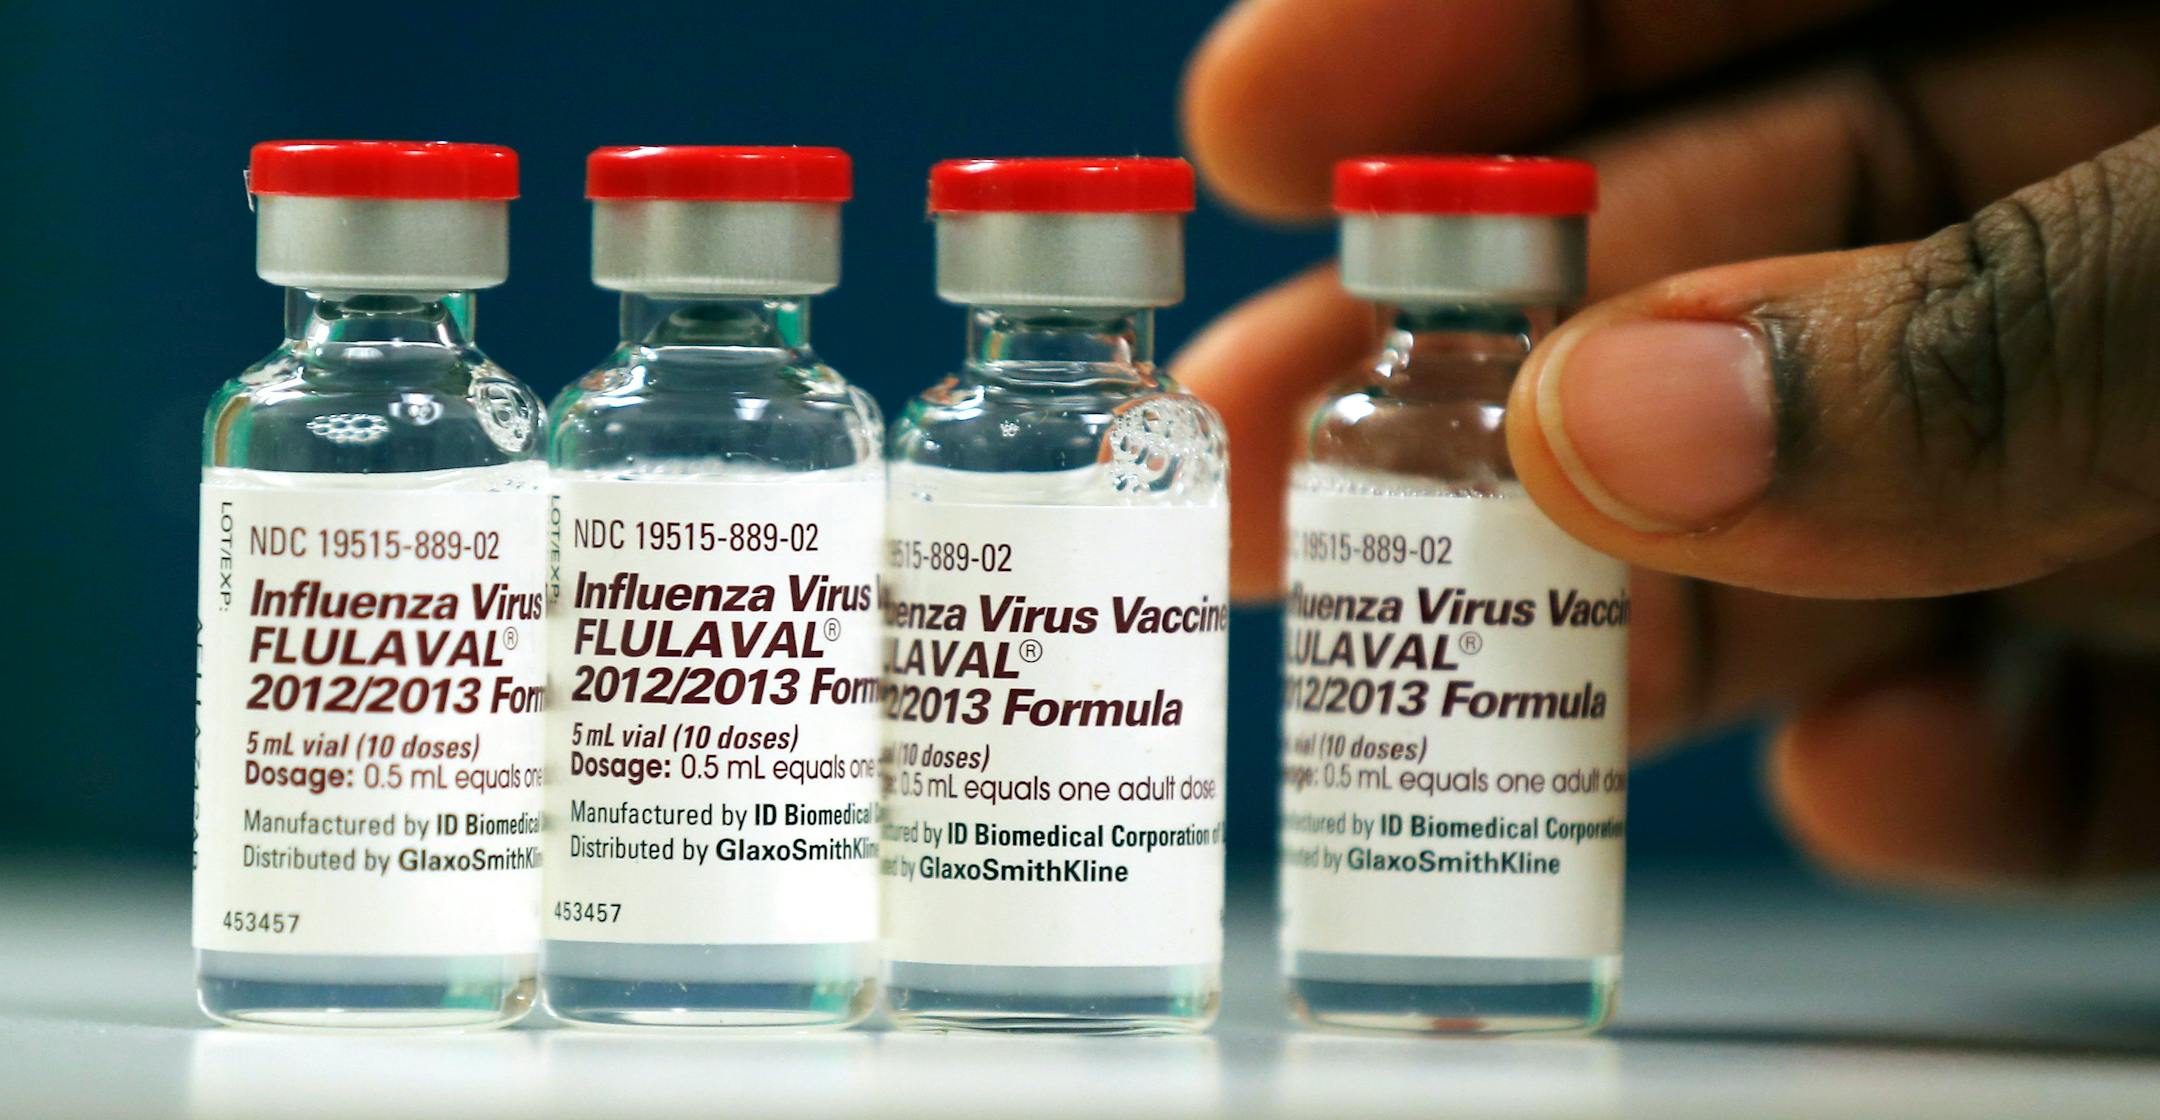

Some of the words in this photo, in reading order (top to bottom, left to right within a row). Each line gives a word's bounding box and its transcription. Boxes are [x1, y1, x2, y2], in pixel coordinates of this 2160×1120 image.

[250, 525, 307, 558] NDC
[318, 528, 500, 561] 19515-889-02
[574, 518, 625, 550] NDC
[635, 521, 819, 552] 19515-889-02
[219, 501, 234, 612] LOT/EXP:
[249, 578, 459, 621] Influenza
[471, 582, 543, 621] Virus
[573, 570, 776, 613] Influenza
[788, 574, 872, 612] Virus
[1417, 586, 1537, 628] Virus
[1548, 589, 1631, 627] Vacci
[979, 594, 1099, 635] Virus
[1113, 596, 1229, 633] Vaccine
[245, 672, 482, 715] 2012/2013
[490, 676, 545, 713] Form
[570, 664, 801, 706] 2012/2013
[810, 667, 881, 705] Form
[1441, 680, 1607, 720] Formula
[1001, 687, 1183, 727] Formula
[246, 730, 260, 755] 5
[262, 731, 295, 757] mL
[303, 732, 351, 758] vial
[355, 732, 396, 761] (10
[400, 733, 480, 763] doses)
[571, 721, 584, 746] 5
[585, 722, 615, 747] mL
[622, 723, 668, 749] vial
[672, 723, 712, 753] (10
[716, 723, 799, 753] doses)
[1320, 734, 1346, 759] (10
[1351, 735, 1427, 764] doses)
[570, 750, 671, 786] Dosage:
[681, 753, 719, 780] 0.5
[727, 754, 766, 780] mL
[772, 754, 846, 786] equals
[850, 759, 874, 778] one
[921, 743, 990, 774] doses)
[244, 759, 354, 796] Dosage:
[363, 762, 404, 790] 0.5
[410, 764, 449, 790] mL
[454, 763, 521, 795] equals
[901, 771, 923, 797] 0.5
[927, 773, 959, 799] mL
[964, 775, 1051, 806] equals
[1058, 781, 1111, 802] one
[1117, 775, 1176, 802] adult
[1324, 763, 1351, 788] 0.5
[1358, 765, 1392, 790] mL
[1400, 767, 1489, 796] equals
[1497, 773, 1545, 793] one
[1552, 768, 1600, 794] adult
[243, 808, 396, 837] Manufactured
[403, 813, 430, 841] by
[436, 813, 459, 836] ID
[571, 799, 713, 826] Manufactured
[721, 803, 748, 832] by
[754, 803, 777, 826] ID
[785, 802, 872, 825] Biomedical
[1352, 812, 1375, 840] by
[1381, 813, 1402, 836] ID
[1411, 814, 1538, 839] Biomedical
[570, 834, 674, 861] Distributed
[683, 837, 709, 866] by
[923, 821, 943, 849] by
[947, 821, 968, 845] ID
[974, 822, 1104, 848] Biomedical
[1112, 824, 1210, 852] Corporation
[242, 843, 357, 872] Distributed
[364, 847, 391, 877] by
[919, 855, 1129, 883] GlaxoSmithKline
[1323, 846, 1342, 874] by
[1347, 846, 1560, 874] GlaxoSmithKline
[223, 910, 301, 934] 453457
[554, 901, 622, 923] 453457
